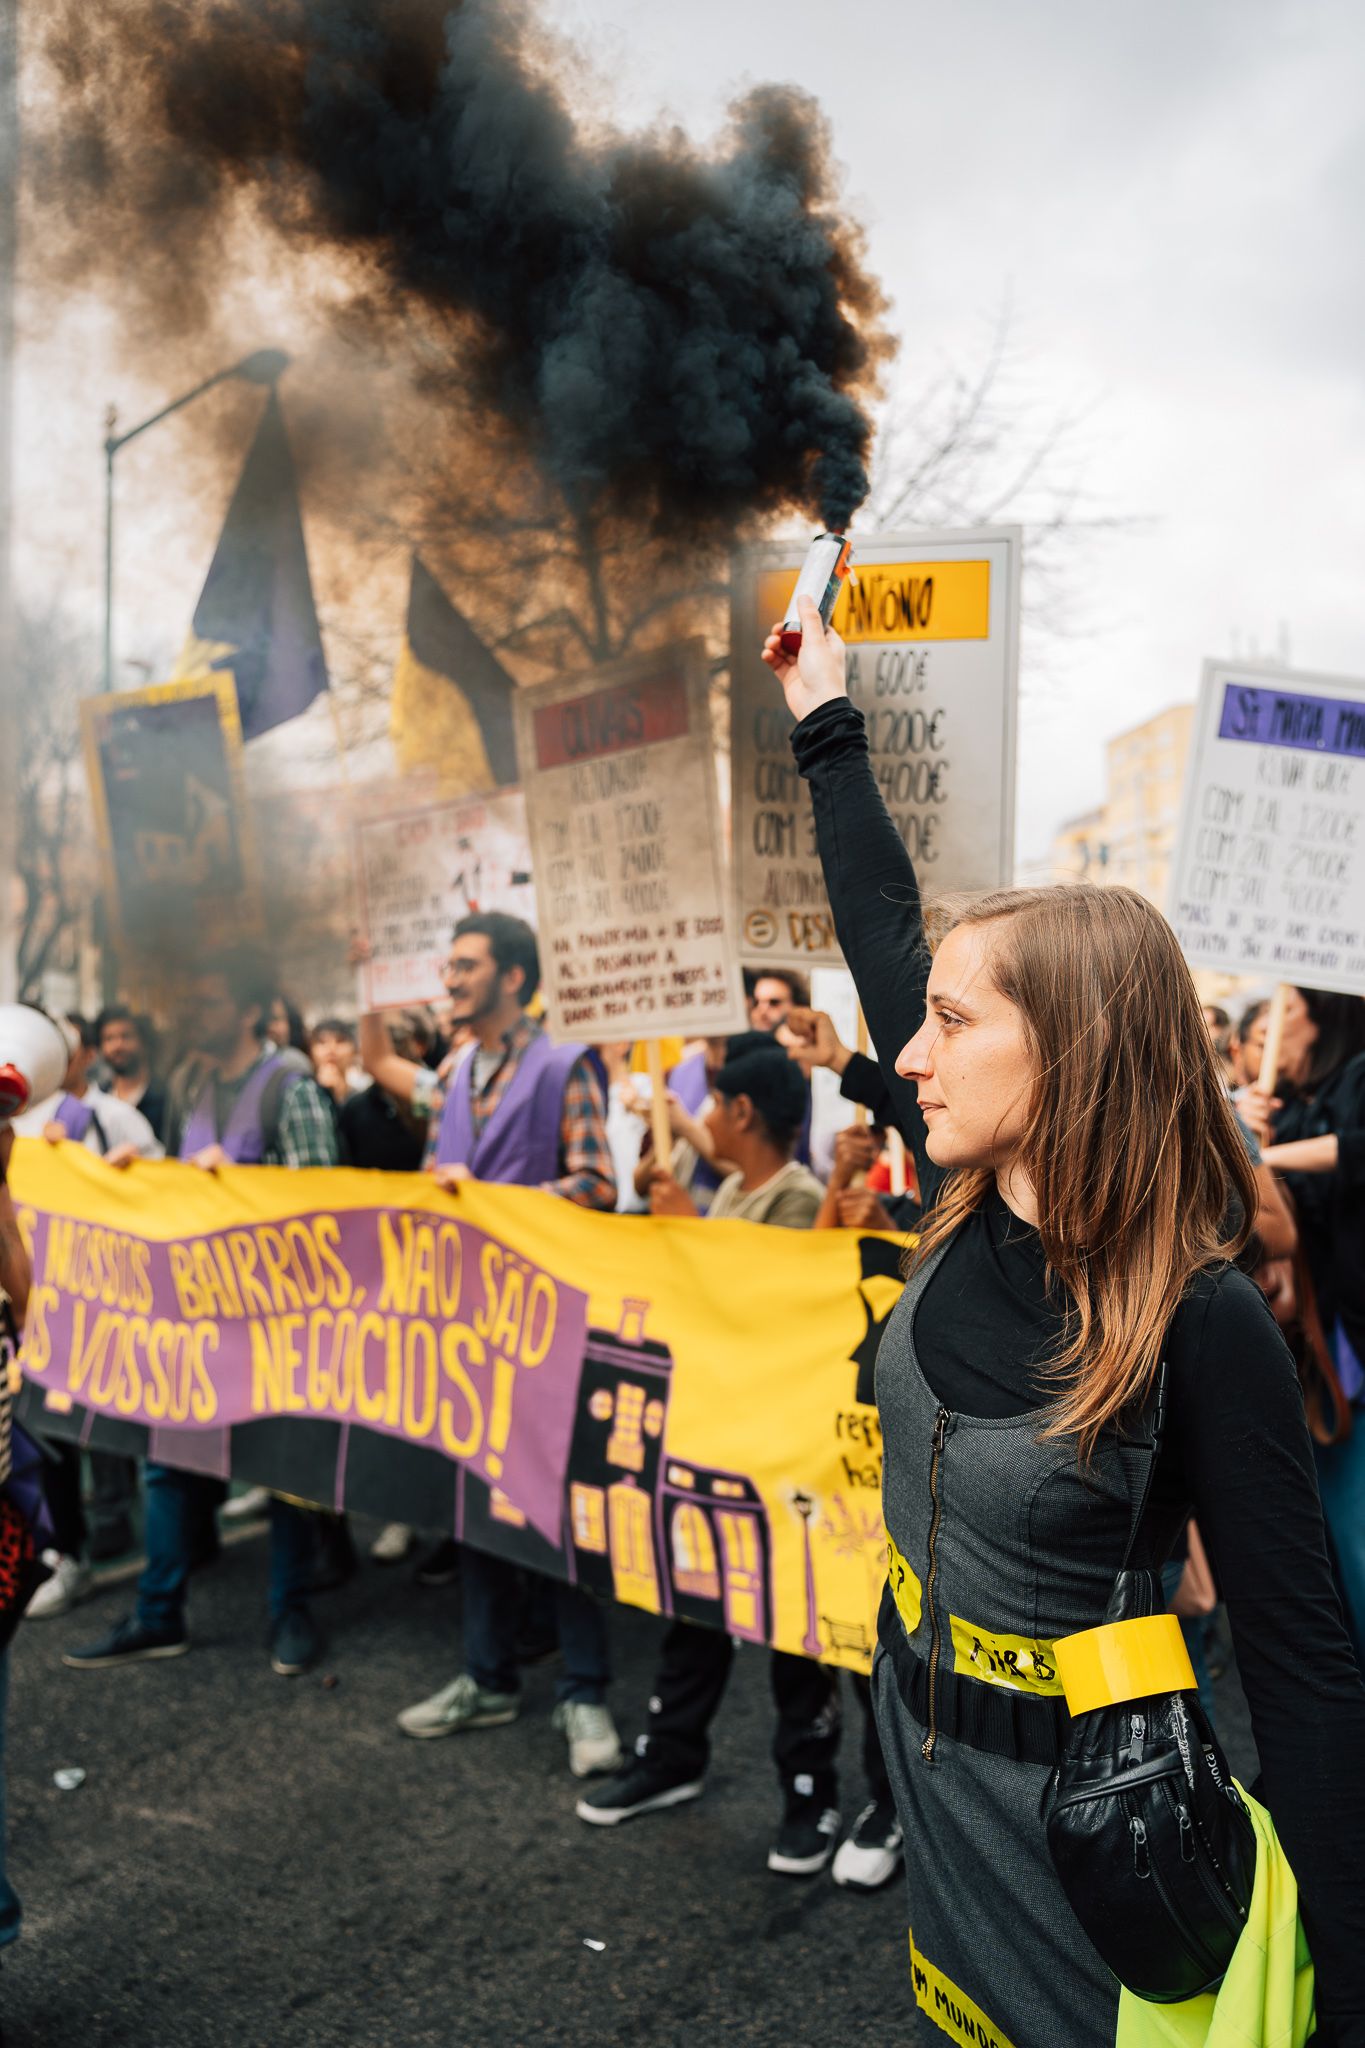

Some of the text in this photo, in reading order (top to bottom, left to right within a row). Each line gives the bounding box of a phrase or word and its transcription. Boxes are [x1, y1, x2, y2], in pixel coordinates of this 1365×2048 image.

[44, 1216, 154, 1316] NOSSOS
[168, 1213, 367, 1320] BAIRROS,
[377, 1210, 463, 1320] NÃO
[473, 1241, 558, 1368] SÃO
[67, 1300, 220, 1424] VOSSOS
[842, 1455, 883, 1490] ha
